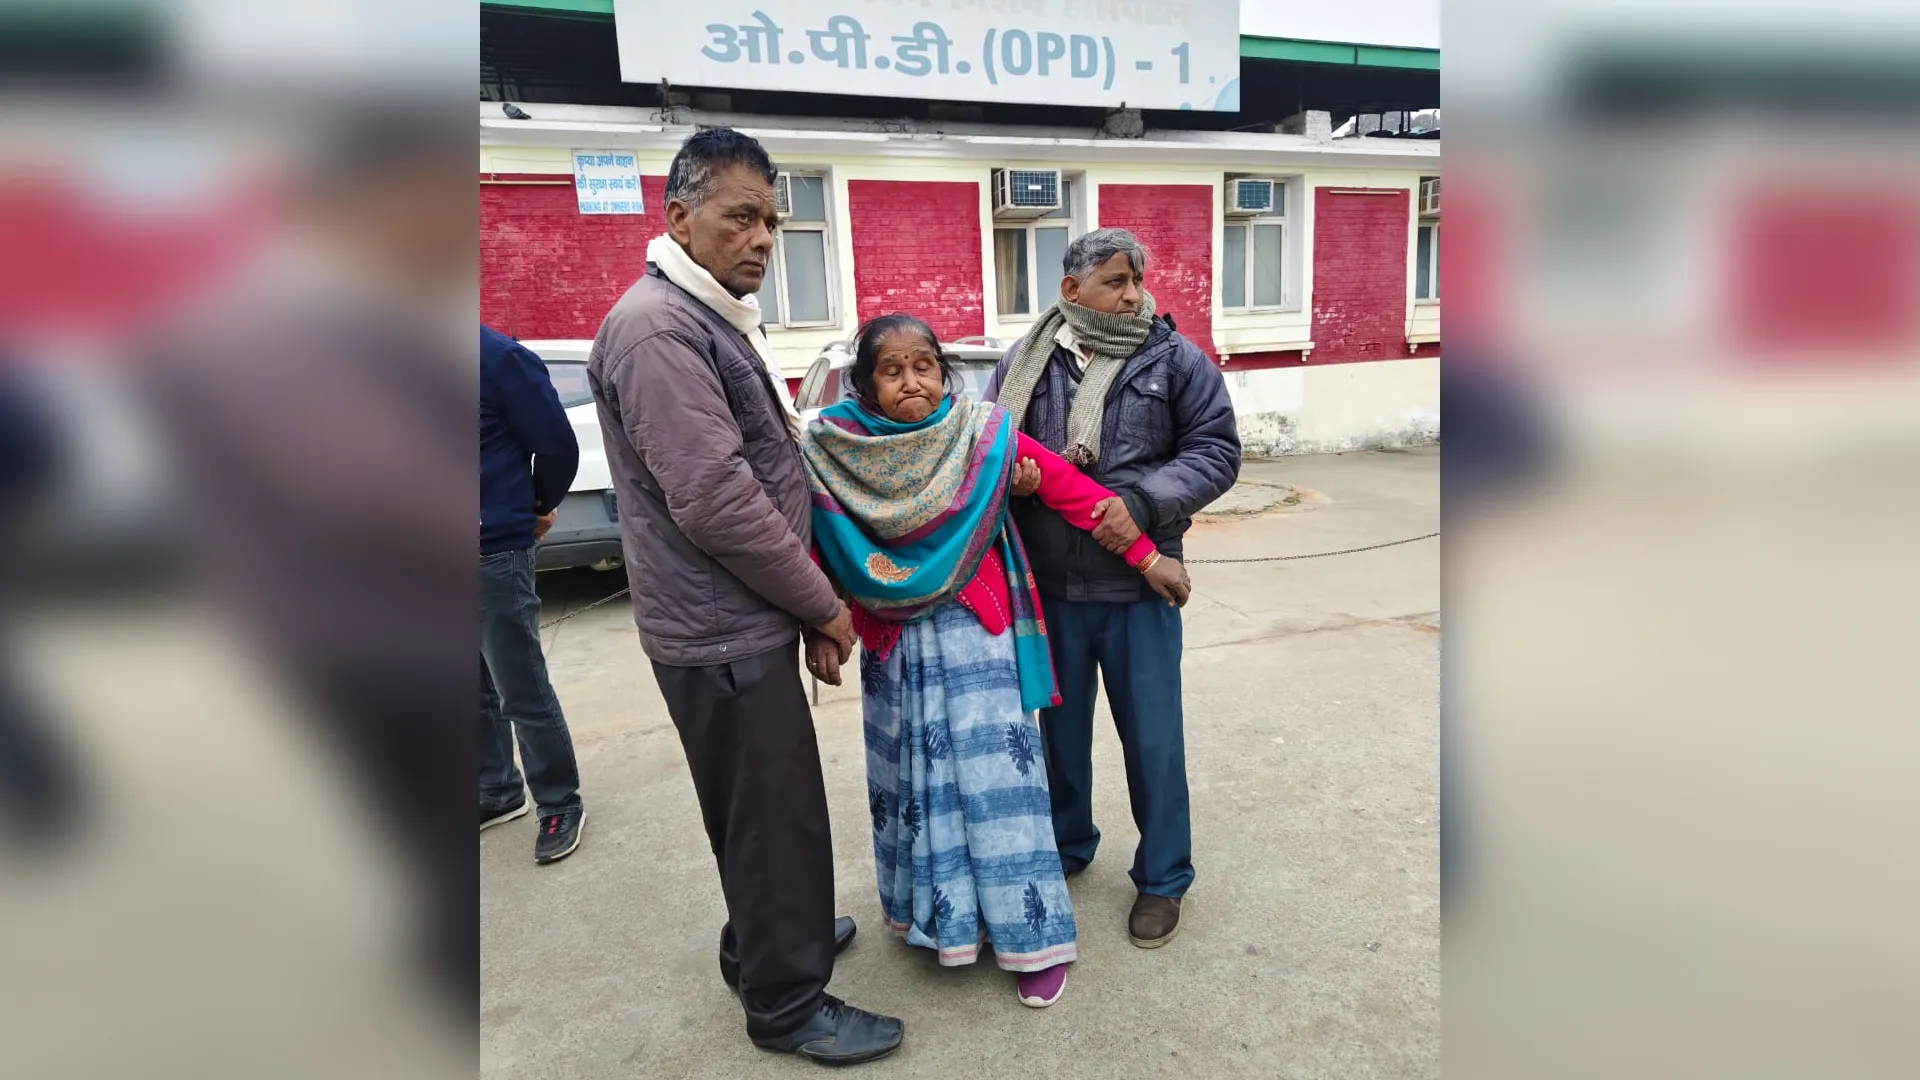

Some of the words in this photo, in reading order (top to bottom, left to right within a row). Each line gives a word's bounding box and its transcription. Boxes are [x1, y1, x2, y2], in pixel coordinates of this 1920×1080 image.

[1136, 61, 1153, 71] -
[1171, 42, 1190, 84] 1
[578, 174, 587, 189] की
